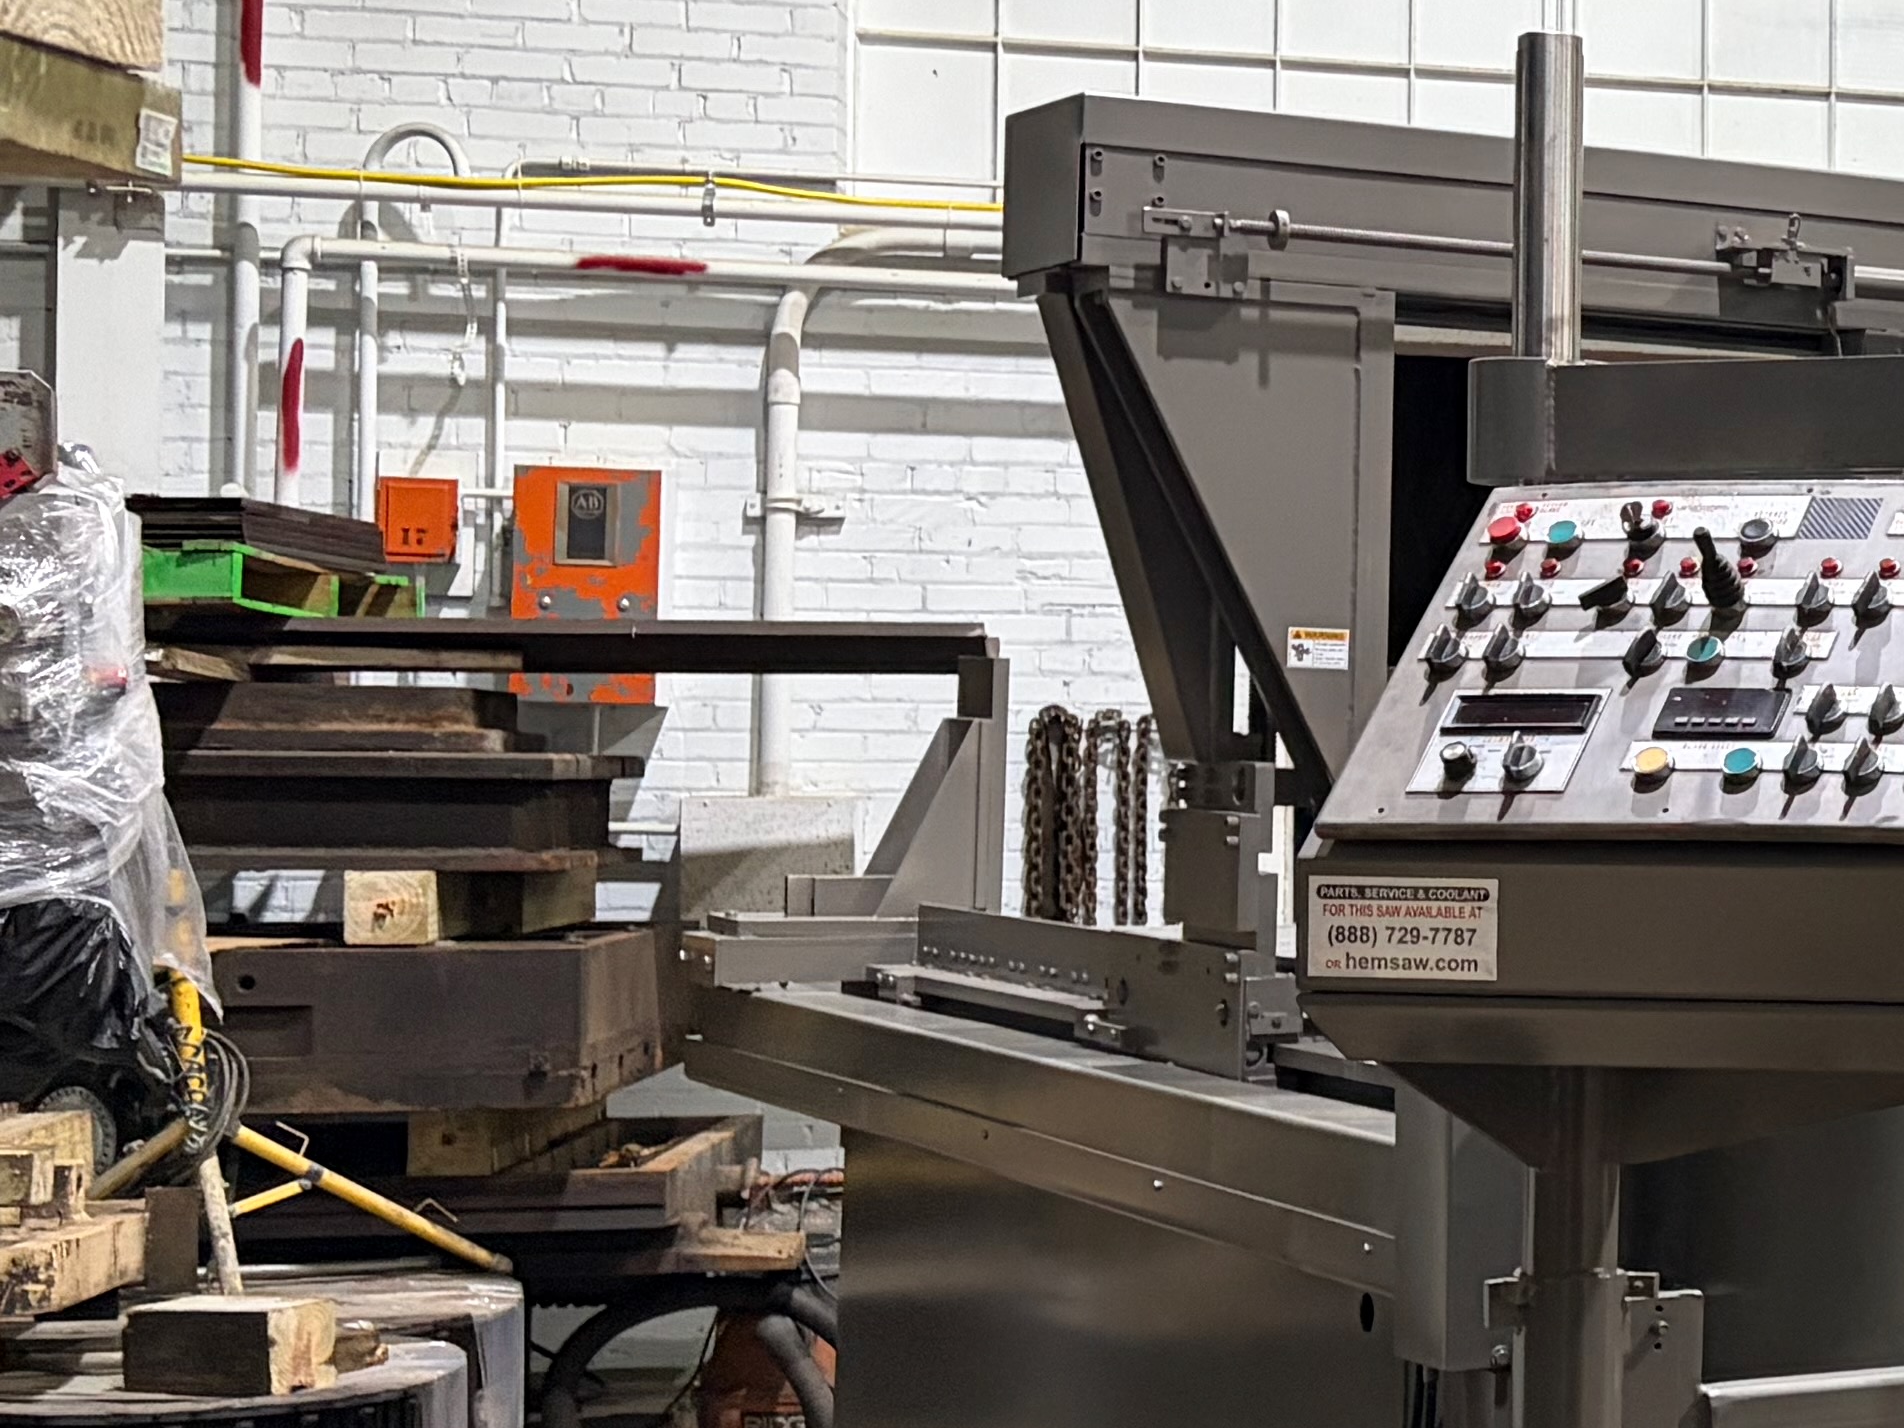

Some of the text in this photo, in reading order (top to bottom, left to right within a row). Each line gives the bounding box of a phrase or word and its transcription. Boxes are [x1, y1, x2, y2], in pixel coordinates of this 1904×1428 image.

[575, 497, 600, 509] AB
[1364, 887, 1415, 899] SERVICE
[1417, 889, 1425, 899] &
[1428, 888, 1487, 901] COOLANT
[1323, 903, 1483, 920] FOR THIS SAW AVAILABLE AT
[1328, 924, 1478, 948] (888) 729-7787
[1325, 951, 1479, 972] OR hemsaw.com
